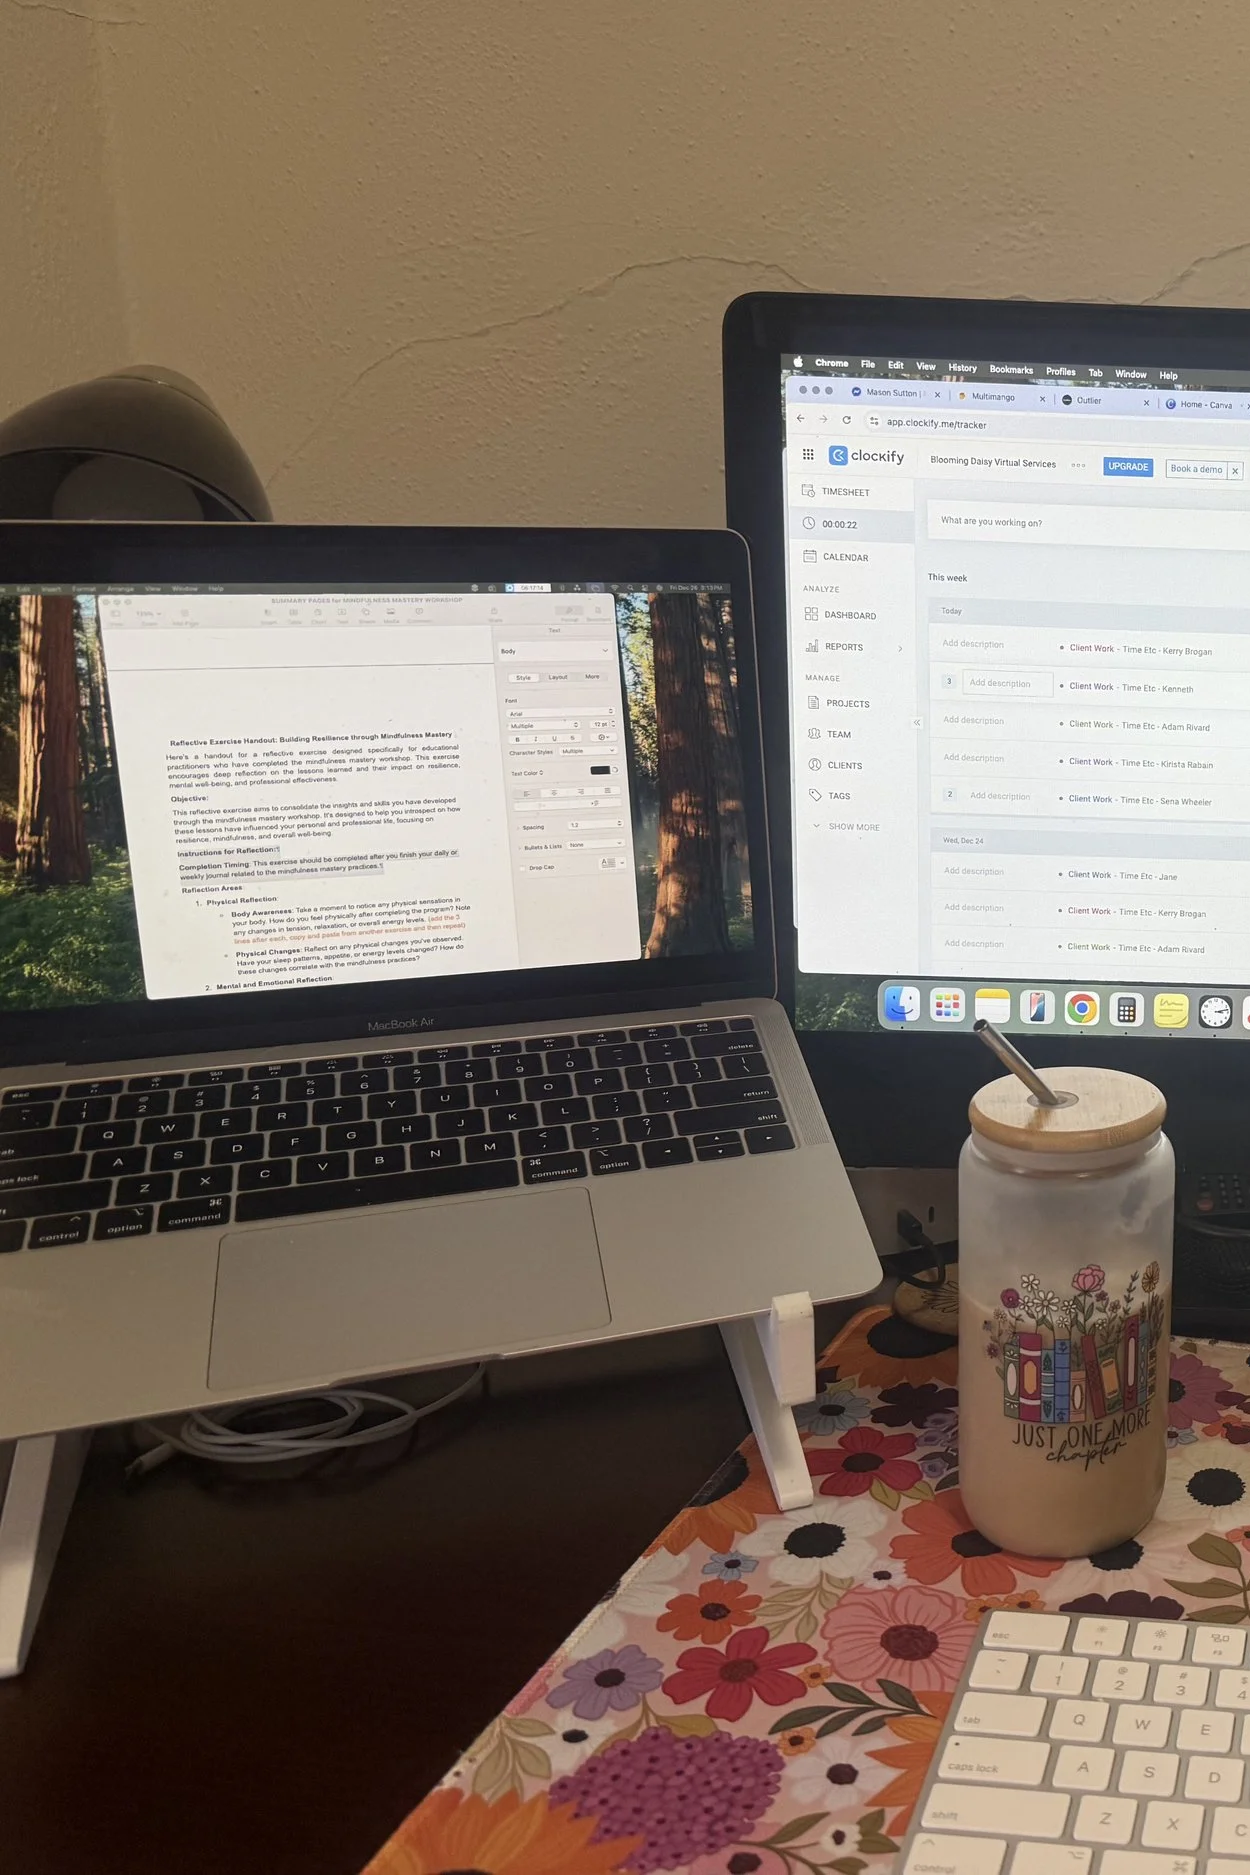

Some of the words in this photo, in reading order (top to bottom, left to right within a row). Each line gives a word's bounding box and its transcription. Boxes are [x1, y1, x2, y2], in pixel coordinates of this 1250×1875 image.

[816, 359, 848, 368] Chrome
[861, 360, 875, 369] File
[888, 361, 904, 370] Edit
[917, 362, 936, 371] View
[949, 363, 977, 374] History
[990, 364, 1033, 375] Bookmarks
[1047, 367, 1076, 377] Profiles
[1089, 368, 1103, 377] Tab
[1115, 369, 1147, 379] Window
[1160, 371, 1178, 382] Help
[867, 388, 890, 397] Mason
[893, 389, 917, 398] Sutton
[972, 392, 1015, 403] Multimango
[1077, 396, 1101, 405] Outlier
[1181, 400, 1202, 409] Home
[1210, 401, 1232, 410] Canva
[887, 417, 987, 430] app.clockify.me/tracker
[852, 450, 904, 465] clockify
[931, 456, 969, 466] Blooming
[971, 457, 992, 468] Daisy
[995, 458, 1020, 467] Virtual
[1023, 460, 1057, 469] Services
[1108, 462, 1149, 472] UPGRADE
[1171, 464, 1191, 473] Book
[1200, 464, 1223, 474] demo
[822, 487, 870, 497] TIMESHEET
[822, 520, 857, 529] 00:00:22
[942, 516, 962, 525] What
[964, 518, 977, 526] are
[979, 519, 992, 528] you
[994, 518, 1026, 528] working
[1028, 518, 1042, 528] on?
[823, 552, 869, 562] CALENDAR
[928, 573, 944, 582] This
[947, 574, 968, 583] week
[803, 585, 840, 593] ANALYZE
[825, 610, 877, 620] DASHBOARD
[942, 607, 962, 616] Today
[825, 642, 863, 652] REPORTS
[1070, 644, 1092, 652] Client
[1094, 644, 1114, 653] Work
[1144, 646, 1156, 654] Etc
[1163, 647, 1183, 656] Kerry
[1185, 648, 1212, 657] Brogan
[805, 673, 840, 683] MANAGE
[1070, 682, 1092, 690] Client
[1094, 682, 1114, 690] Work
[827, 699, 870, 709] PROJECTS
[827, 730, 851, 739] TEAM
[828, 761, 863, 770] CLIENTS
[171, 795, 208, 803] Objective:
[829, 792, 851, 801] TAGS
[829, 822, 854, 831] SHOW
[856, 823, 880, 832] MORE
[943, 836, 958, 845] Wed,
[960, 836, 973, 845] Dec
[975, 837, 984, 845] 24
[178, 850, 222, 858] Instructions
[368, 1019, 418, 1032] MacBook
[420, 1017, 435, 1028] Air
[744, 1089, 770, 1097] return
[758, 1113, 778, 1121] shift
[532, 1167, 578, 1179] command
[168, 1212, 221, 1225] command
[108, 1223, 143, 1234] option
[39, 1231, 79, 1242] control
[1012, 1423, 1057, 1449] JUST
[1067, 1422, 1103, 1448] ONE
[1112, 1403, 1151, 1439] MORE
[1045, 1431, 1128, 1471] chapter
[963, 1715, 981, 1725] tab
[1074, 1713, 1085, 1727] Q
[1135, 1719, 1151, 1731] W
[1201, 1724, 1210, 1736] E
[948, 1761, 973, 1773] caps
[977, 1762, 998, 1773] lock
